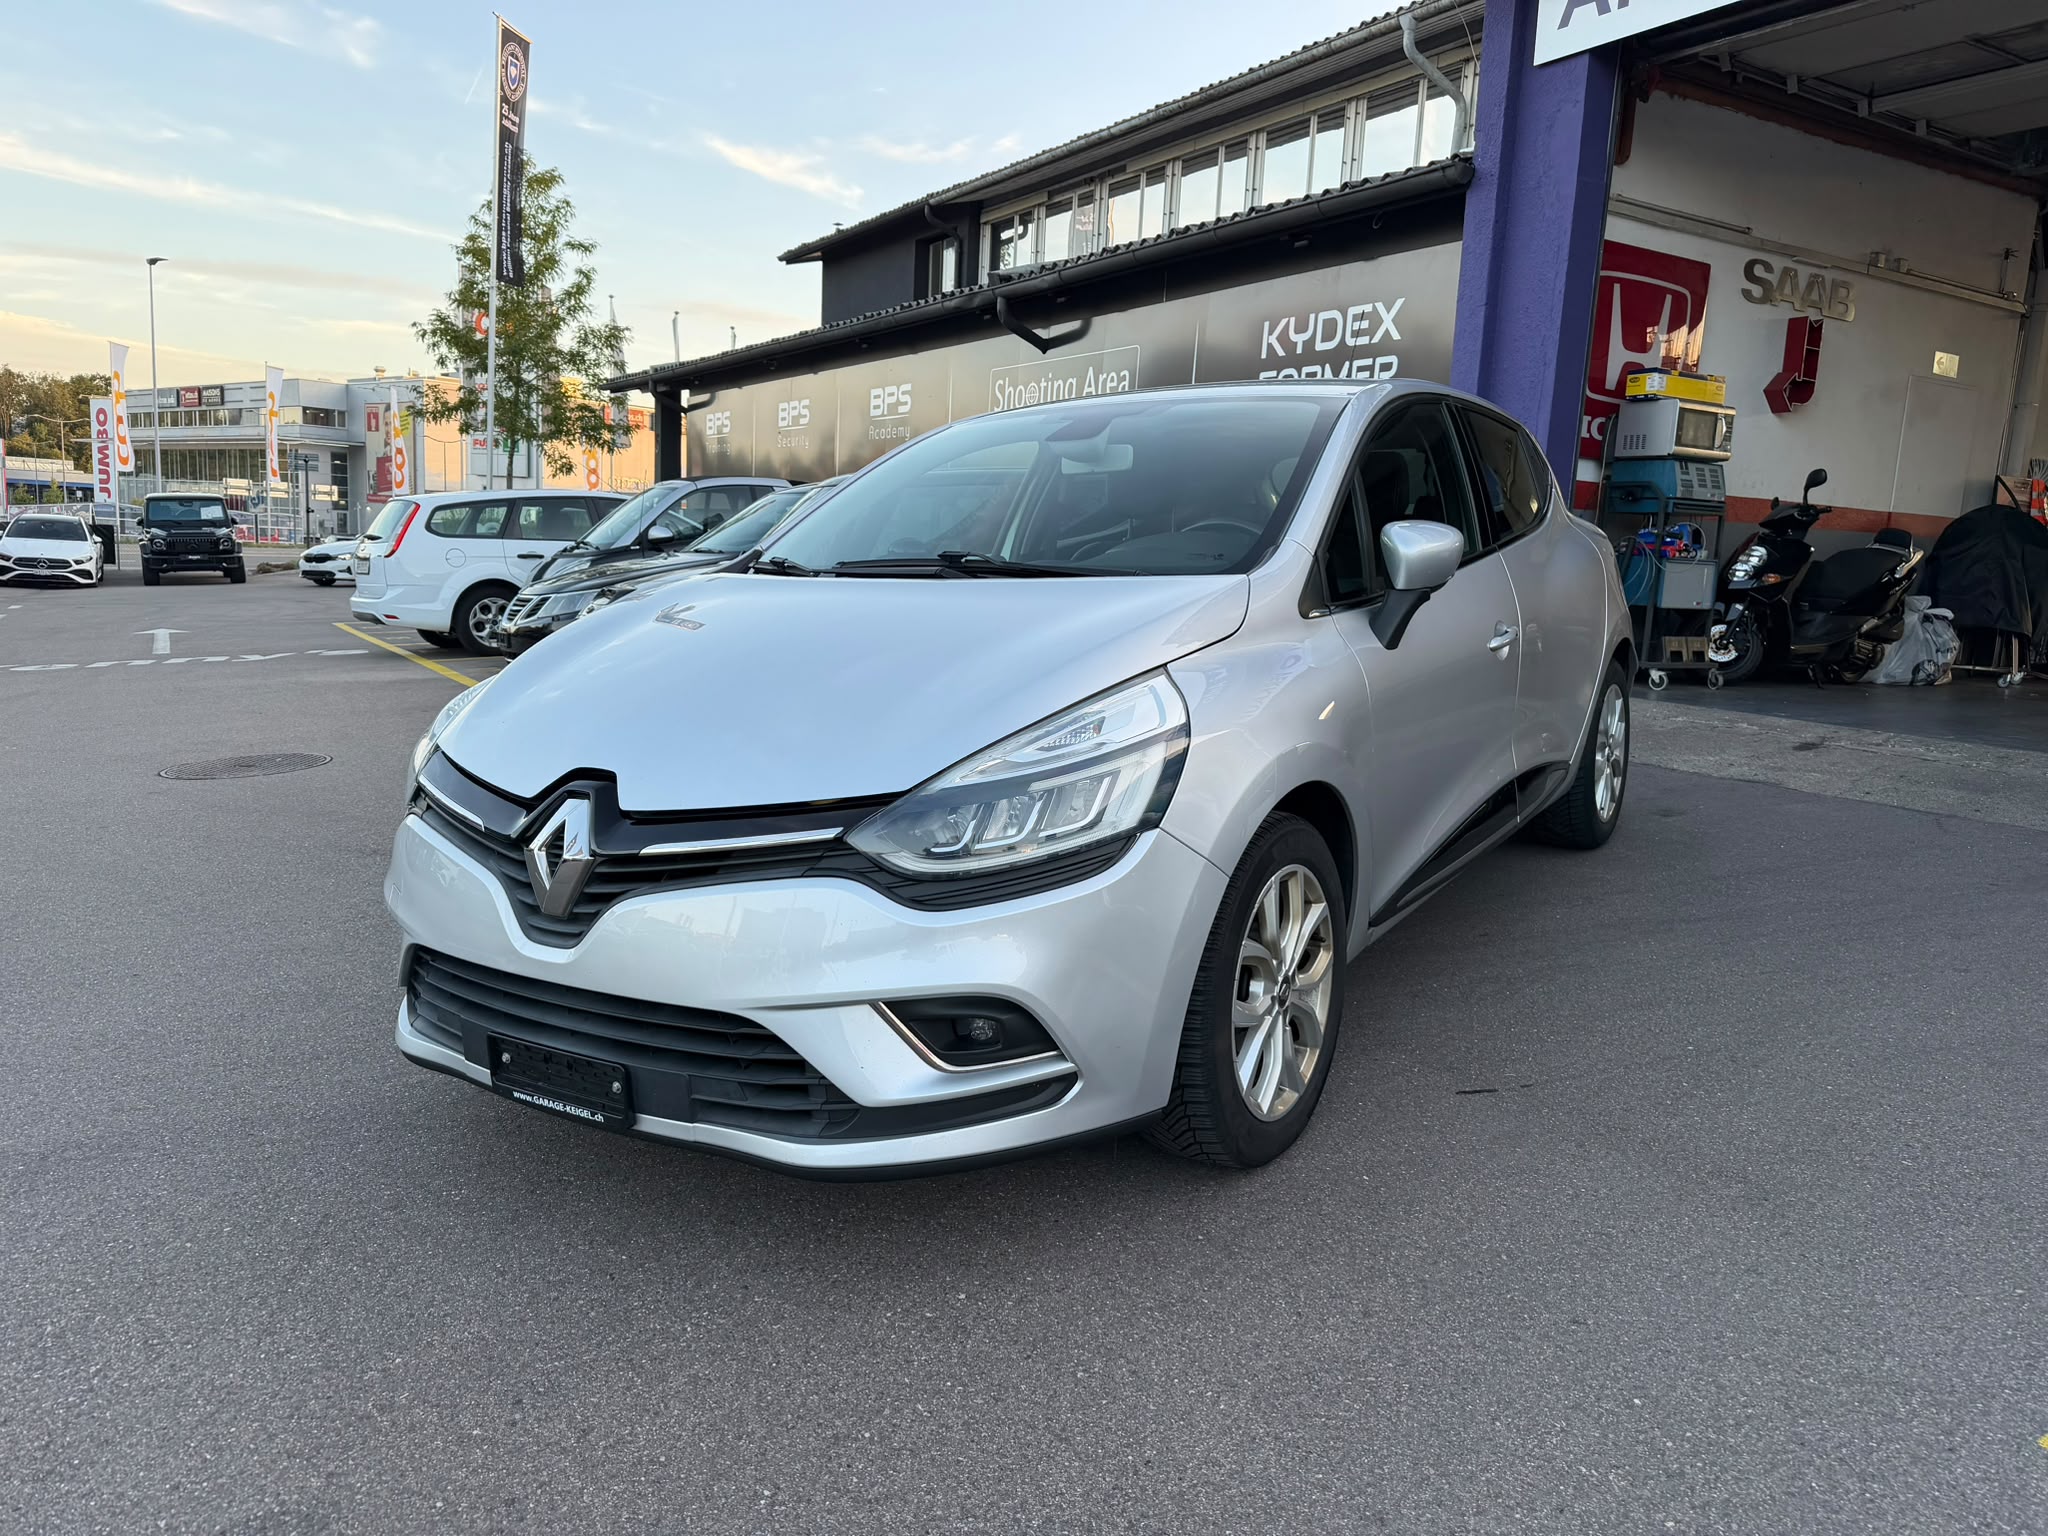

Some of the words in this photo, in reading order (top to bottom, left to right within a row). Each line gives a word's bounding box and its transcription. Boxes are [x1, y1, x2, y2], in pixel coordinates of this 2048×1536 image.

[1741, 258, 1857, 322] SAAB
[1260, 297, 1406, 359] KYDEX
[870, 383, 912, 416] BPS
[994, 372, 1077, 412] Shooting
[1082, 366, 1130, 397] Area
[706, 411, 731, 435] BPS
[778, 399, 810, 427] BPS
[777, 434, 809, 449] Security
[869, 424, 911, 441] Academy
[95, 407, 112, 499] JUMBO
[512, 1090, 605, 1123] www.GARAGE-KEIGEL.ch
